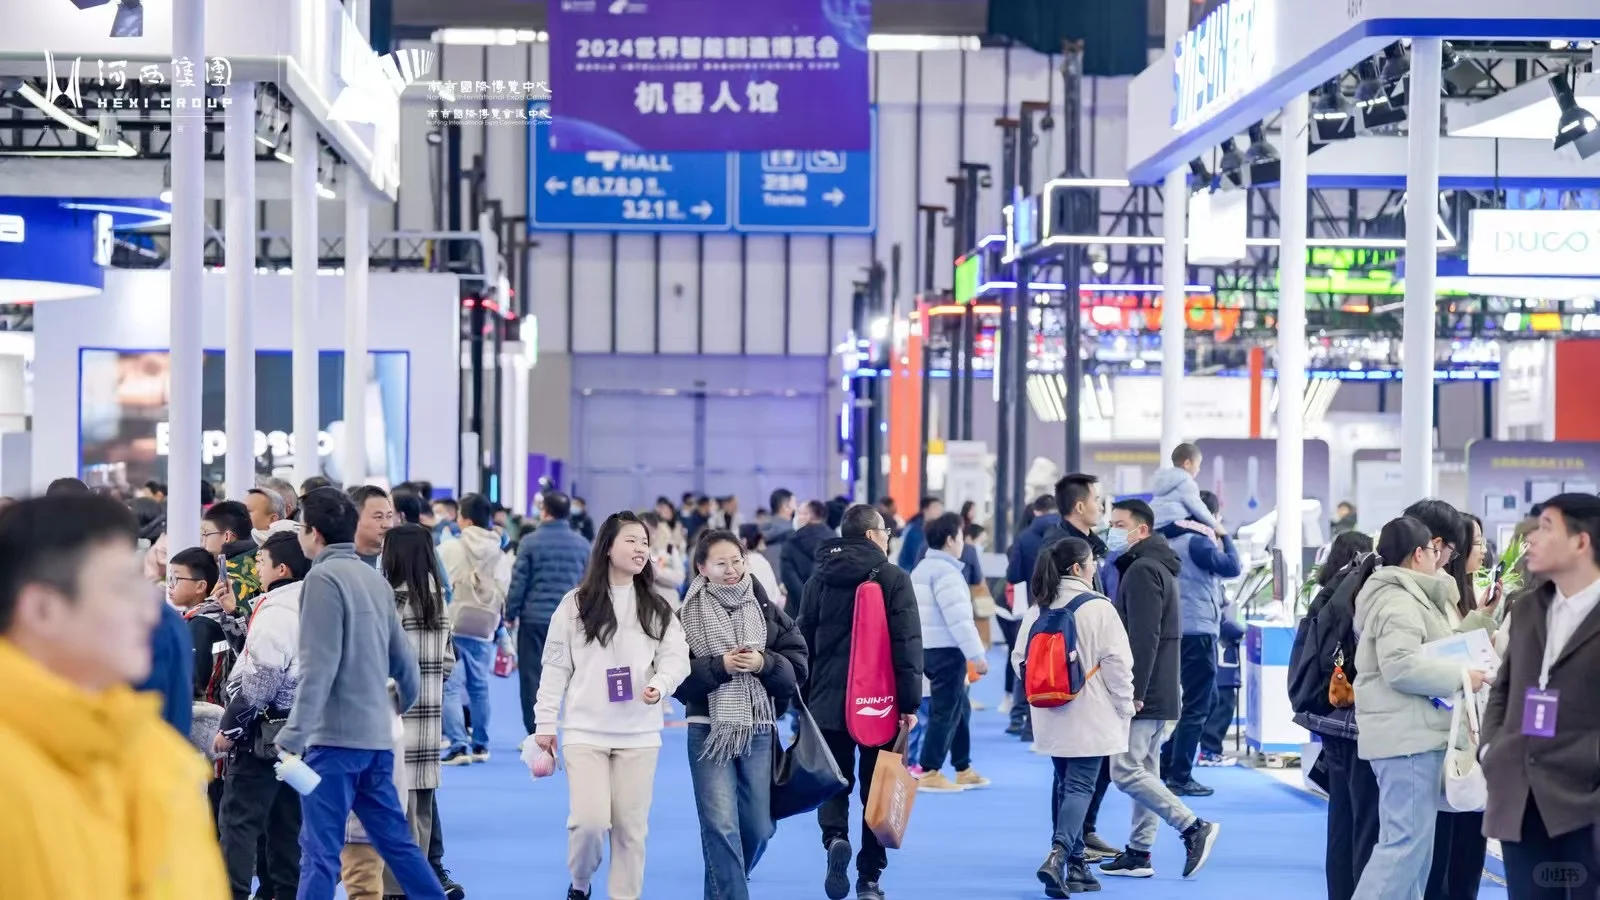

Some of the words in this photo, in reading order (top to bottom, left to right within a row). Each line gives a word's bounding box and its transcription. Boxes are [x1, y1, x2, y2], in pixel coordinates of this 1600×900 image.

[634, 79, 779, 114] 机器人馆
[620, 153, 673, 172] HALL
[855, 695, 894, 705] LI-NING
